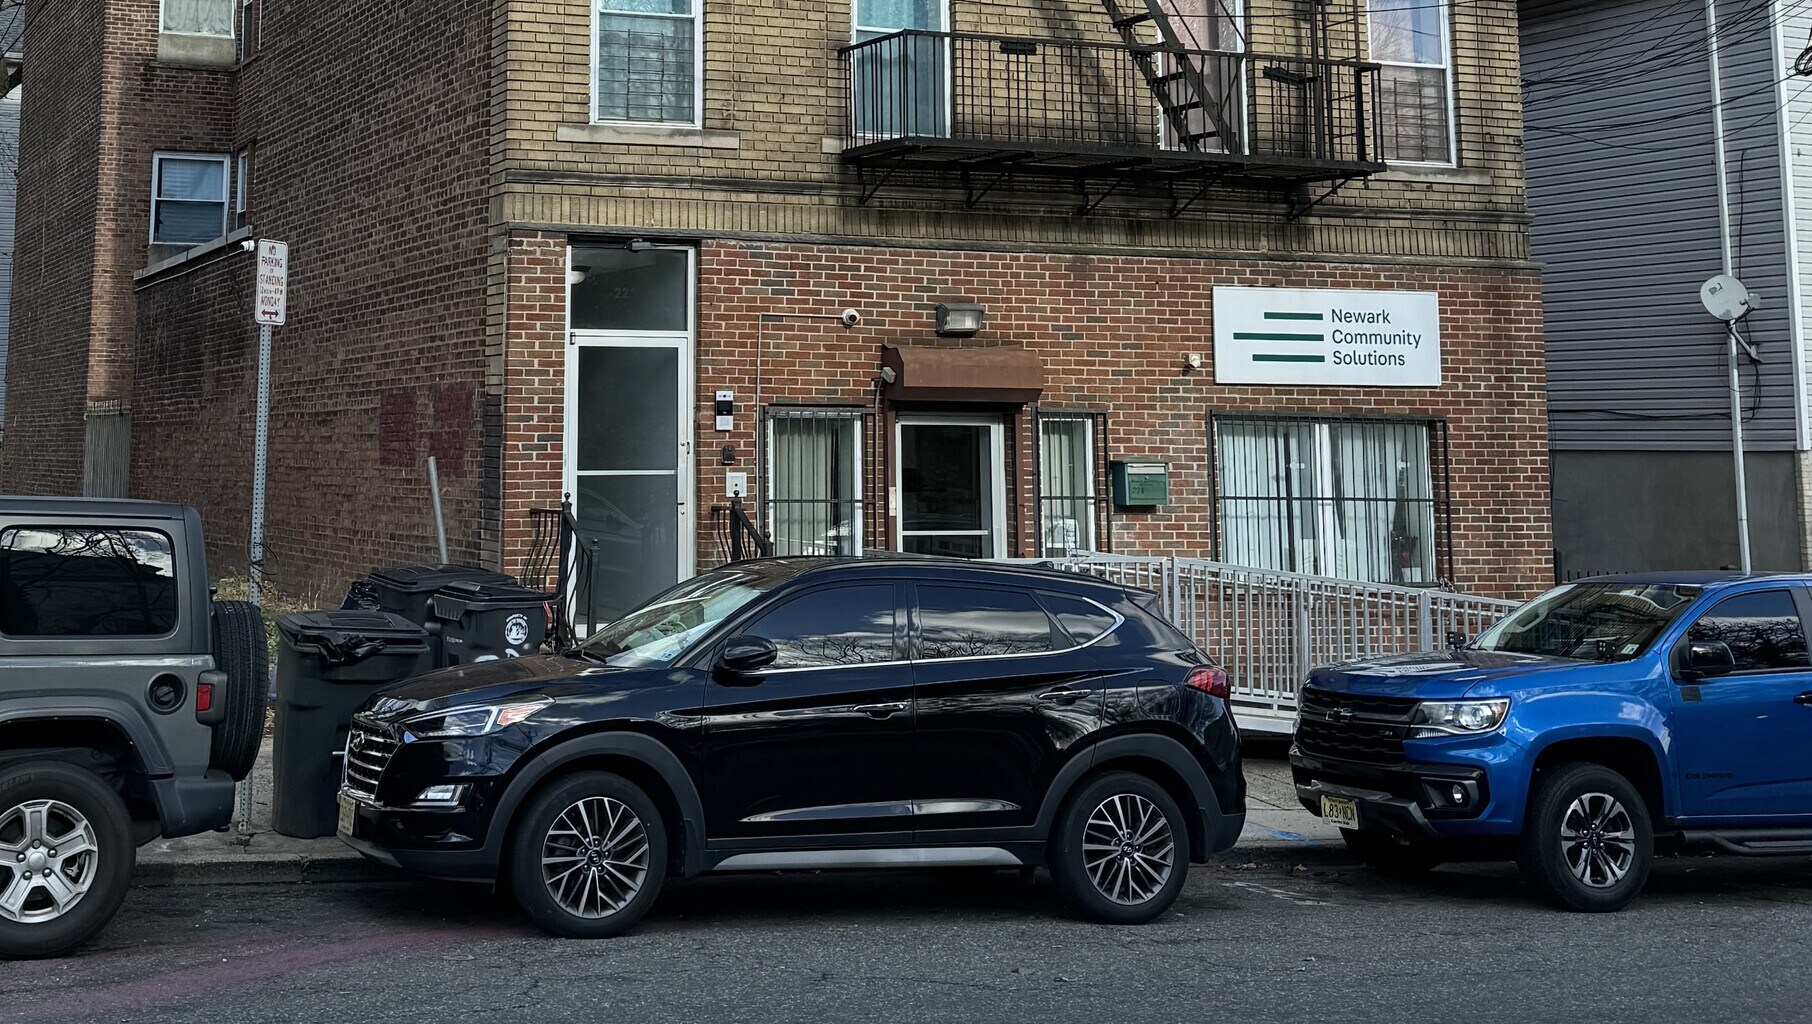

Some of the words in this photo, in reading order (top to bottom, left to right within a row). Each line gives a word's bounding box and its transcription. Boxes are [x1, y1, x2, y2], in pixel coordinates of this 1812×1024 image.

[268, 245, 277, 256] NO
[261, 256, 283, 268] PARKING
[259, 274, 284, 287] STANDING
[260, 295, 281, 308] MONDAY
[1331, 309, 1391, 324] Newark
[1332, 329, 1421, 349] Community
[1333, 350, 1405, 366] Solutions
